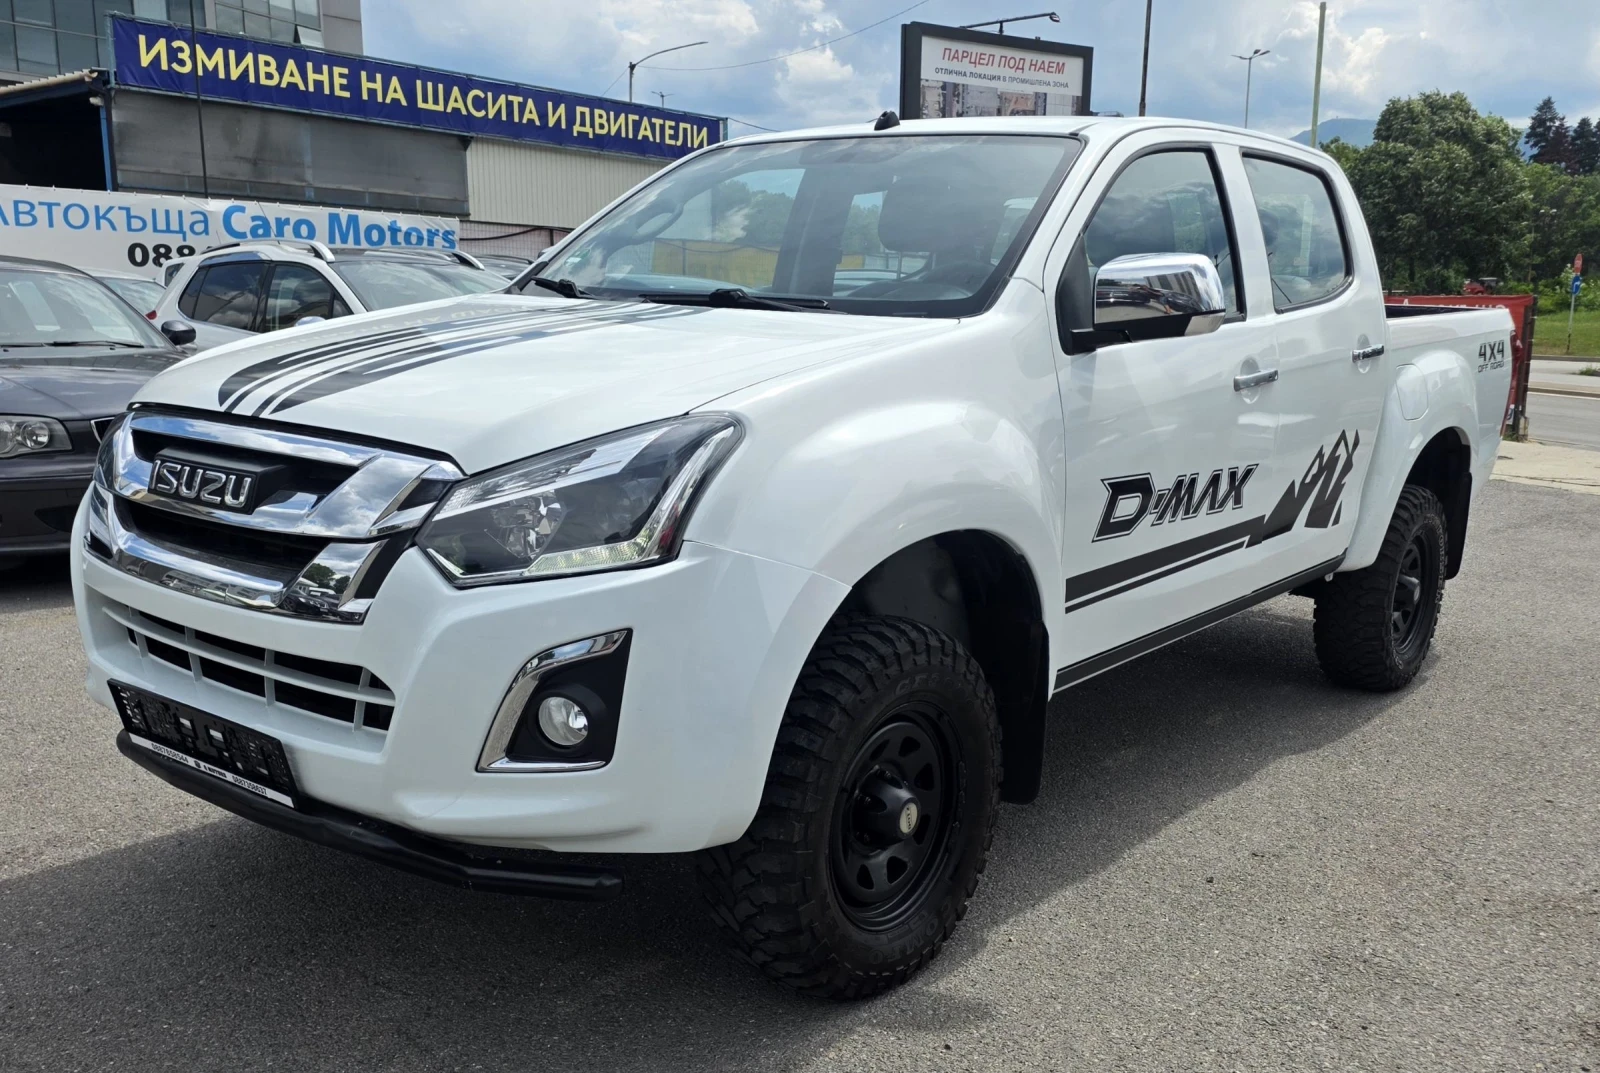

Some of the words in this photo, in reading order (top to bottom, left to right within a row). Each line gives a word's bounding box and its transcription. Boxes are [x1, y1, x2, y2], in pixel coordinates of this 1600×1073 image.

[934, 67, 967, 78] ОТЛИЧНА
[968, 72, 1001, 82] ЛОКАЦИЯ
[1008, 76, 1051, 88] ПРОМИШЛЕНА
[1052, 81, 1069, 89] ЗОНА
[942, 48, 996, 68] ПАРЦЕЛ
[998, 55, 1026, 74] ПОД
[1029, 59, 1066, 75] НАЕМ
[138, 34, 351, 98] ИЗМИВАНЕ
[361, 71, 407, 106] НА
[416, 80, 540, 126] ШАСИТА
[548, 101, 566, 129] И
[573, 106, 708, 149] ДВИГАТЕЛИ
[222, 204, 317, 240] Caro
[328, 212, 457, 250] Motors
[150, 460, 252, 508] ISUZU
[1091, 463, 1260, 543] D-MAX
